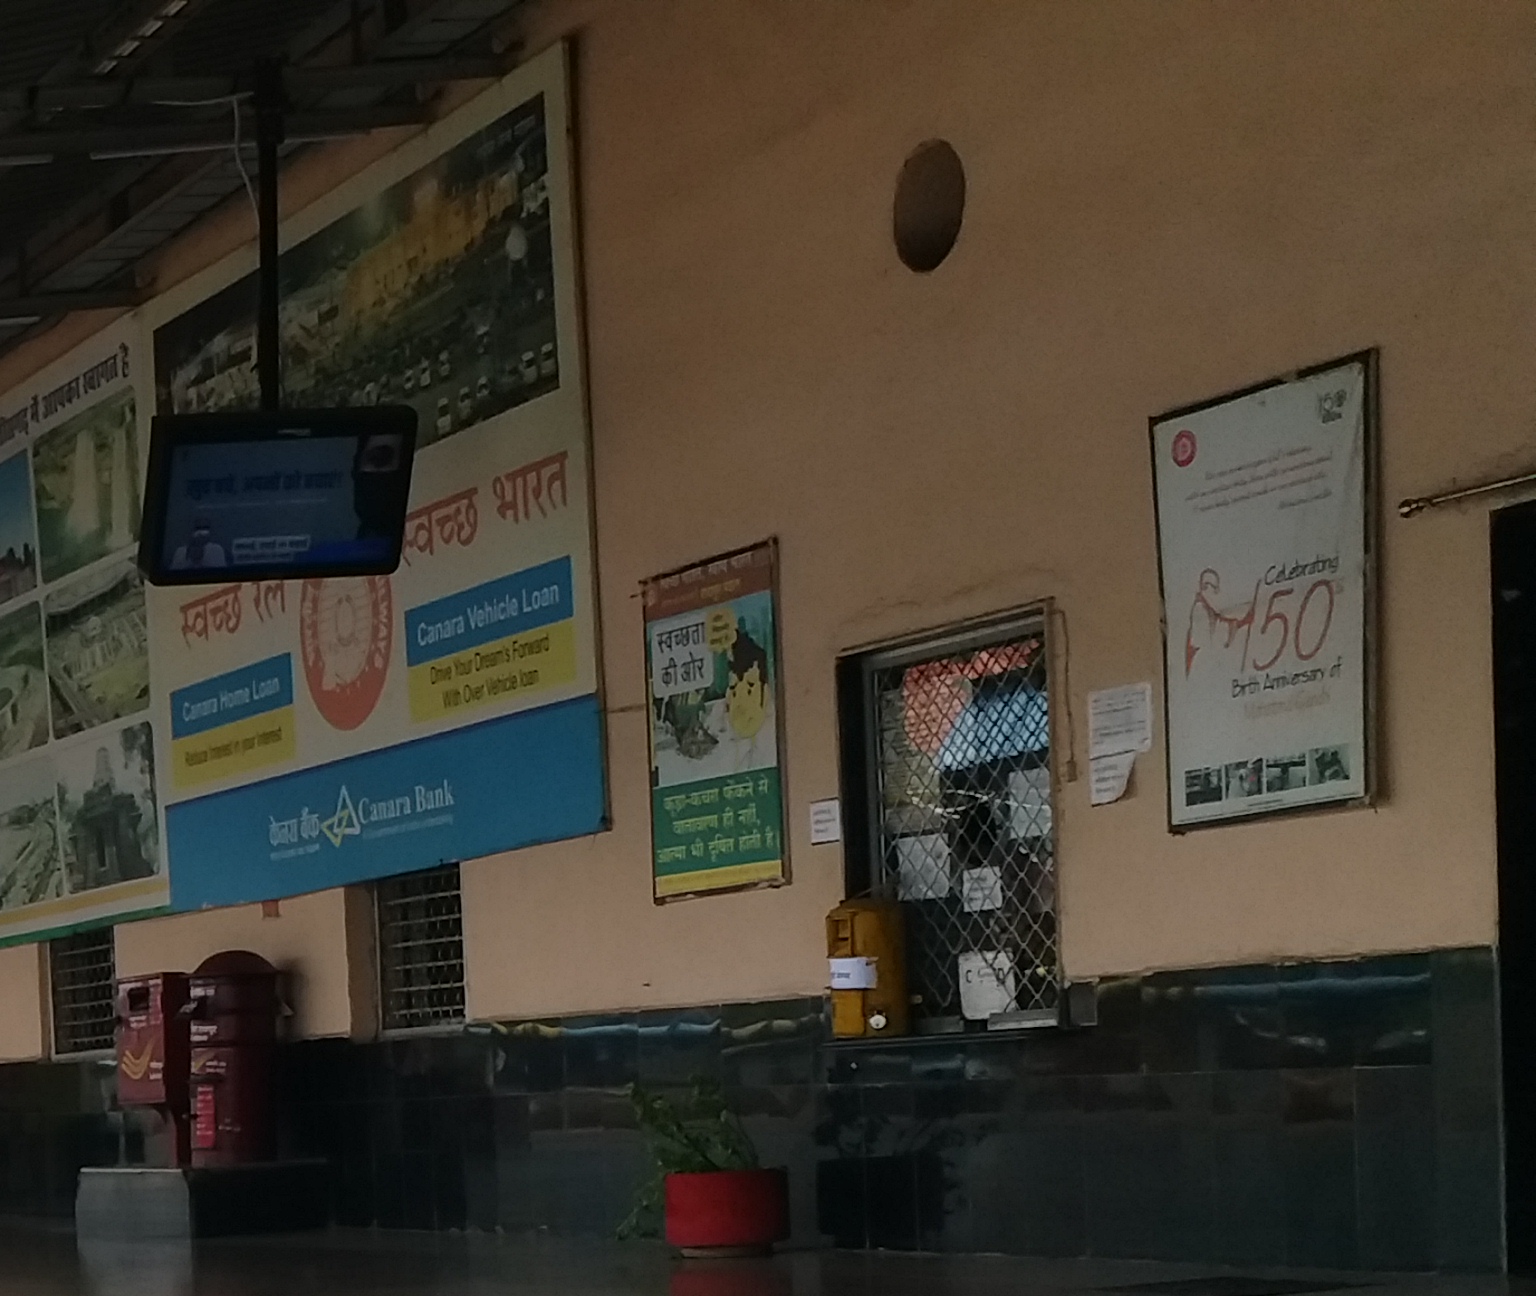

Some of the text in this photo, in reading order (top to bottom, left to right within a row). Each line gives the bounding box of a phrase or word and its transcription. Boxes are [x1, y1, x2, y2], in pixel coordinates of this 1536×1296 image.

[42, 377, 80, 419] आपका
[83, 354, 117, 394] स्वागत
[119, 342, 129, 378] है
[403, 450, 568, 567] स्वच्छ भारत
[1264, 552, 1340, 585] Celebrating
[179, 584, 242, 649] स्वच्छ
[251, 580, 286, 622] रल
[418, 584, 559, 646] Canara Vehicle Loan
[430, 633, 550, 684] Drive Your Dream's Forward
[656, 622, 706, 653] स्वच्छता
[442, 687, 460, 708] With
[486, 672, 518, 696] Vehicle
[661, 651, 704, 687] की ओर
[1232, 655, 1342, 698] Birth Anniversary of
[183, 677, 280, 721] Canara Home Loan
[301, 806, 320, 839] बैंक
[358, 779, 455, 824] Canara Bank
[723, 807, 734, 828] ही
[691, 837, 704, 857] भी
